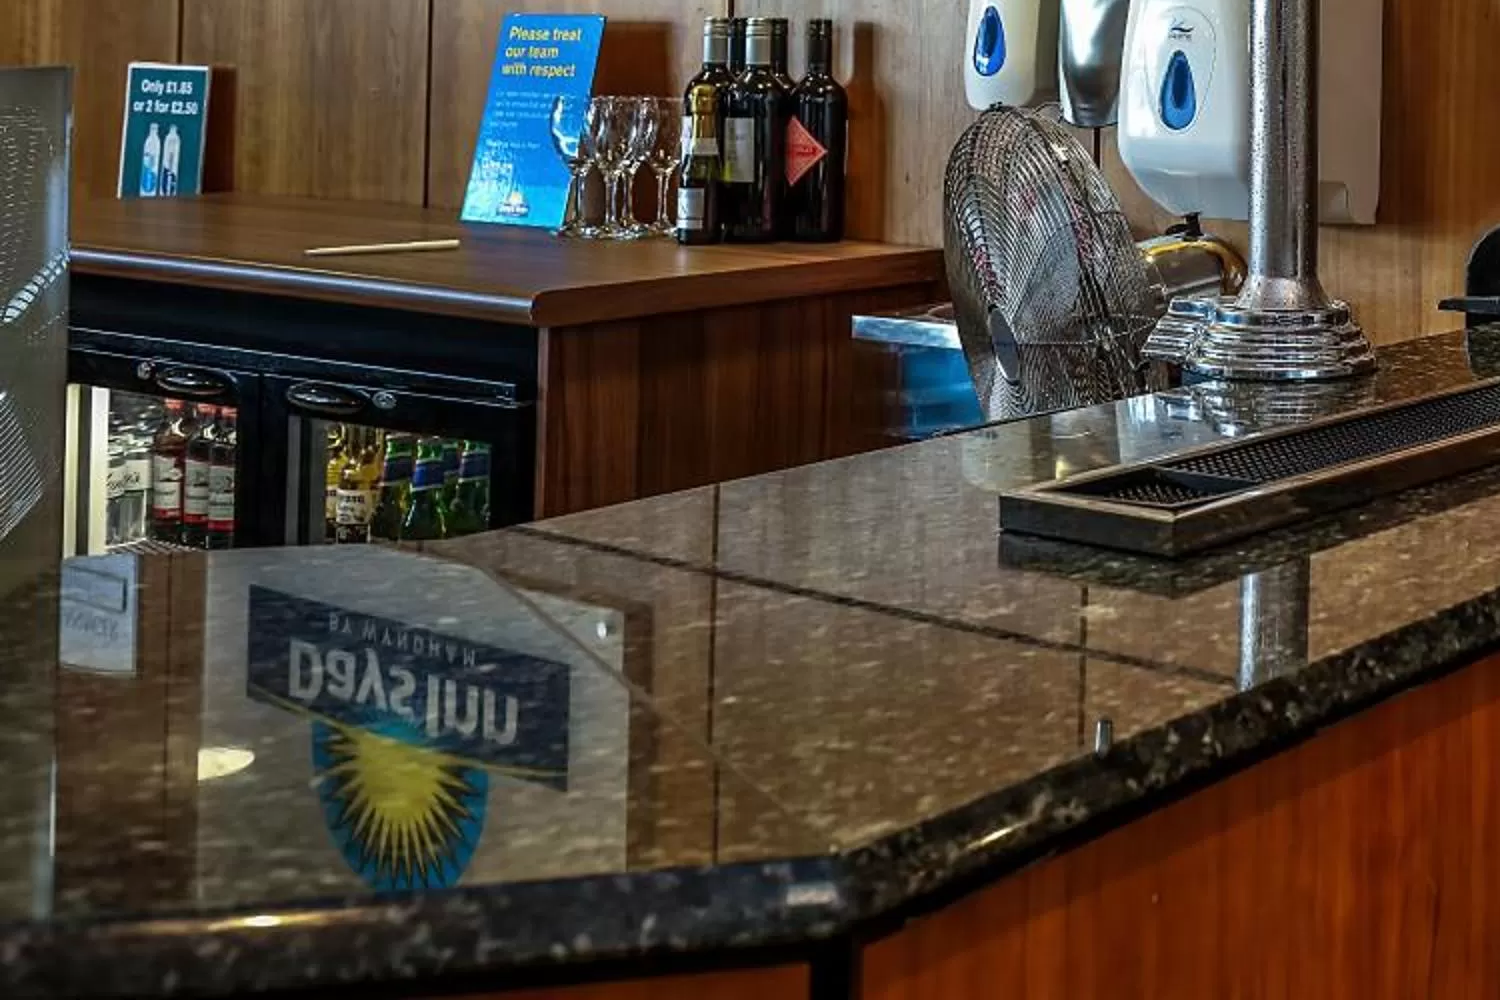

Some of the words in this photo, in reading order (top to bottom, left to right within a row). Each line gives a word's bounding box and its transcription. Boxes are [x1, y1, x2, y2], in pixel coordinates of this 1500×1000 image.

[509, 25, 550, 41] Please
[553, 26, 582, 42] treat
[505, 46, 526, 59] our
[528, 45, 559, 59] team
[501, 62, 527, 76] with
[529, 63, 576, 79] respect
[141, 78, 164, 96] Only
[133, 101, 144, 112] or
[146, 99, 153, 112] 2
[154, 99, 169, 113] for
[171, 100, 199, 115] £2.50
